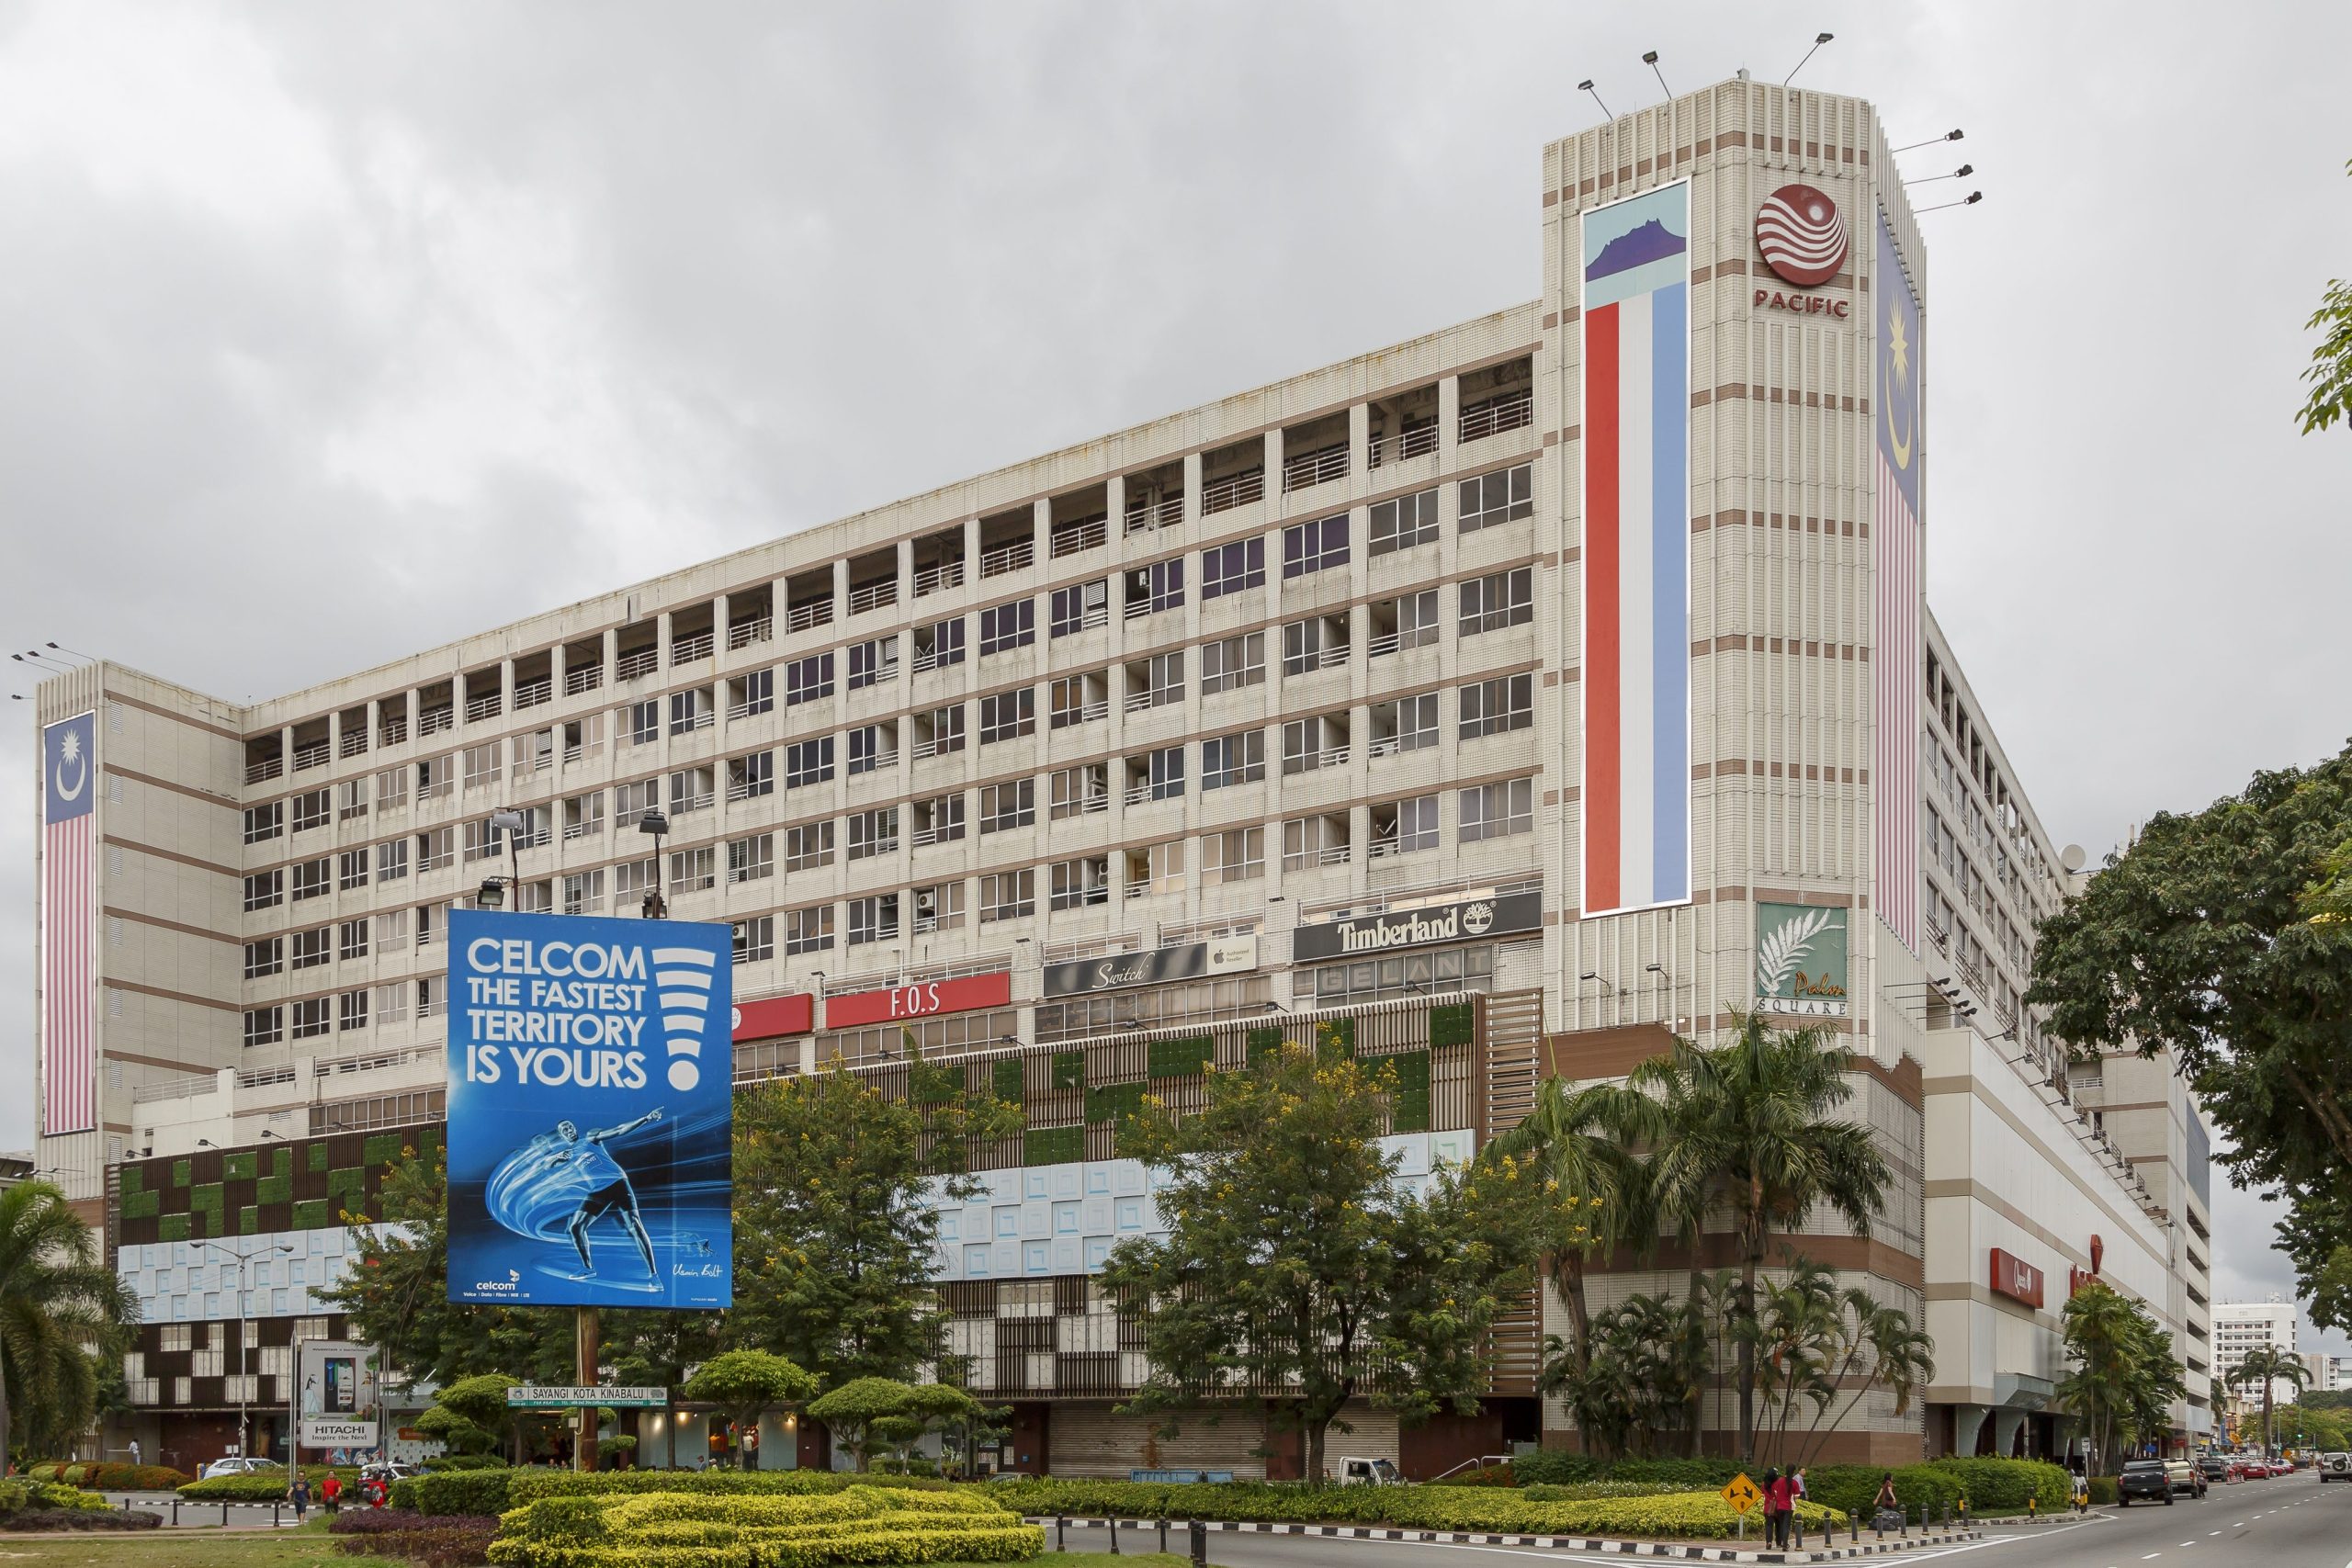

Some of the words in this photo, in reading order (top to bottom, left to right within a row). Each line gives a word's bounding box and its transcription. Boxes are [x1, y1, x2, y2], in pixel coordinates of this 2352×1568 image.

[1754, 288, 1849, 318] PACIFIC
[1337, 907, 1459, 953] Timberland
[467, 937, 648, 980] CELCOM
[1091, 952, 1156, 988] Switch
[467, 976, 520, 1006] THE
[531, 980, 647, 1011] FASTEST
[891, 983, 940, 1017] F.O.S
[1794, 970, 1847, 997] Palm
[1758, 998, 1846, 1015] SQUARE
[467, 1009, 648, 1047] TERRITORY
[467, 1044, 501, 1084] IS
[508, 1046, 648, 1089] YOURS
[476, 1280, 515, 1291] celcom
[532, 1388, 569, 1399] SAYANGI
[573, 1388, 596, 1399] KOTA
[600, 1388, 643, 1399] KINABALU
[315, 1426, 365, 1434] HITACHI
